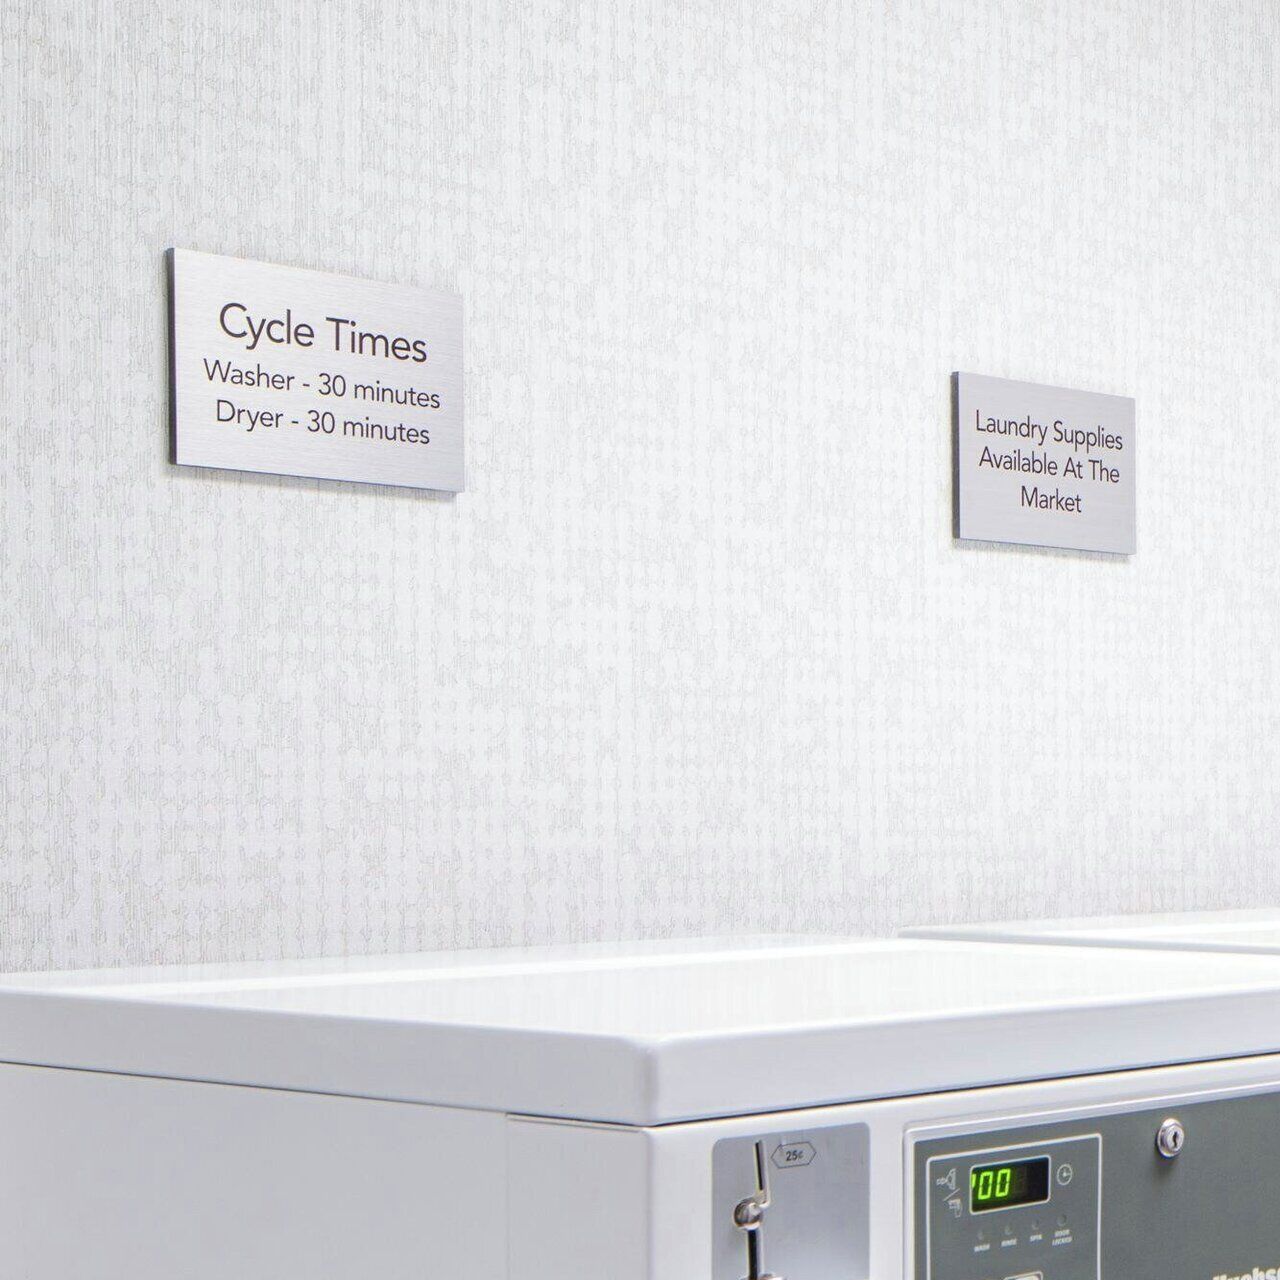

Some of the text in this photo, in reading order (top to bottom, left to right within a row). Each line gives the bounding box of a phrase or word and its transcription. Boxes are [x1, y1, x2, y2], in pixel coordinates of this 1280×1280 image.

[220, 303, 427, 363] Cycle Times
[204, 358, 295, 391] Washer
[318, 373, 346, 397] 30
[354, 380, 440, 409] minutes
[216, 399, 284, 432] Dryer
[307, 410, 335, 434] 30
[344, 418, 430, 445] minutes
[976, 409, 1123, 454] Laundry Supplies
[979, 446, 1120, 483] Available At The
[1021, 486, 1082, 513] Market
[786, 1150, 804, 1161] 25¢
[971, 1168, 1011, 1200] 00
